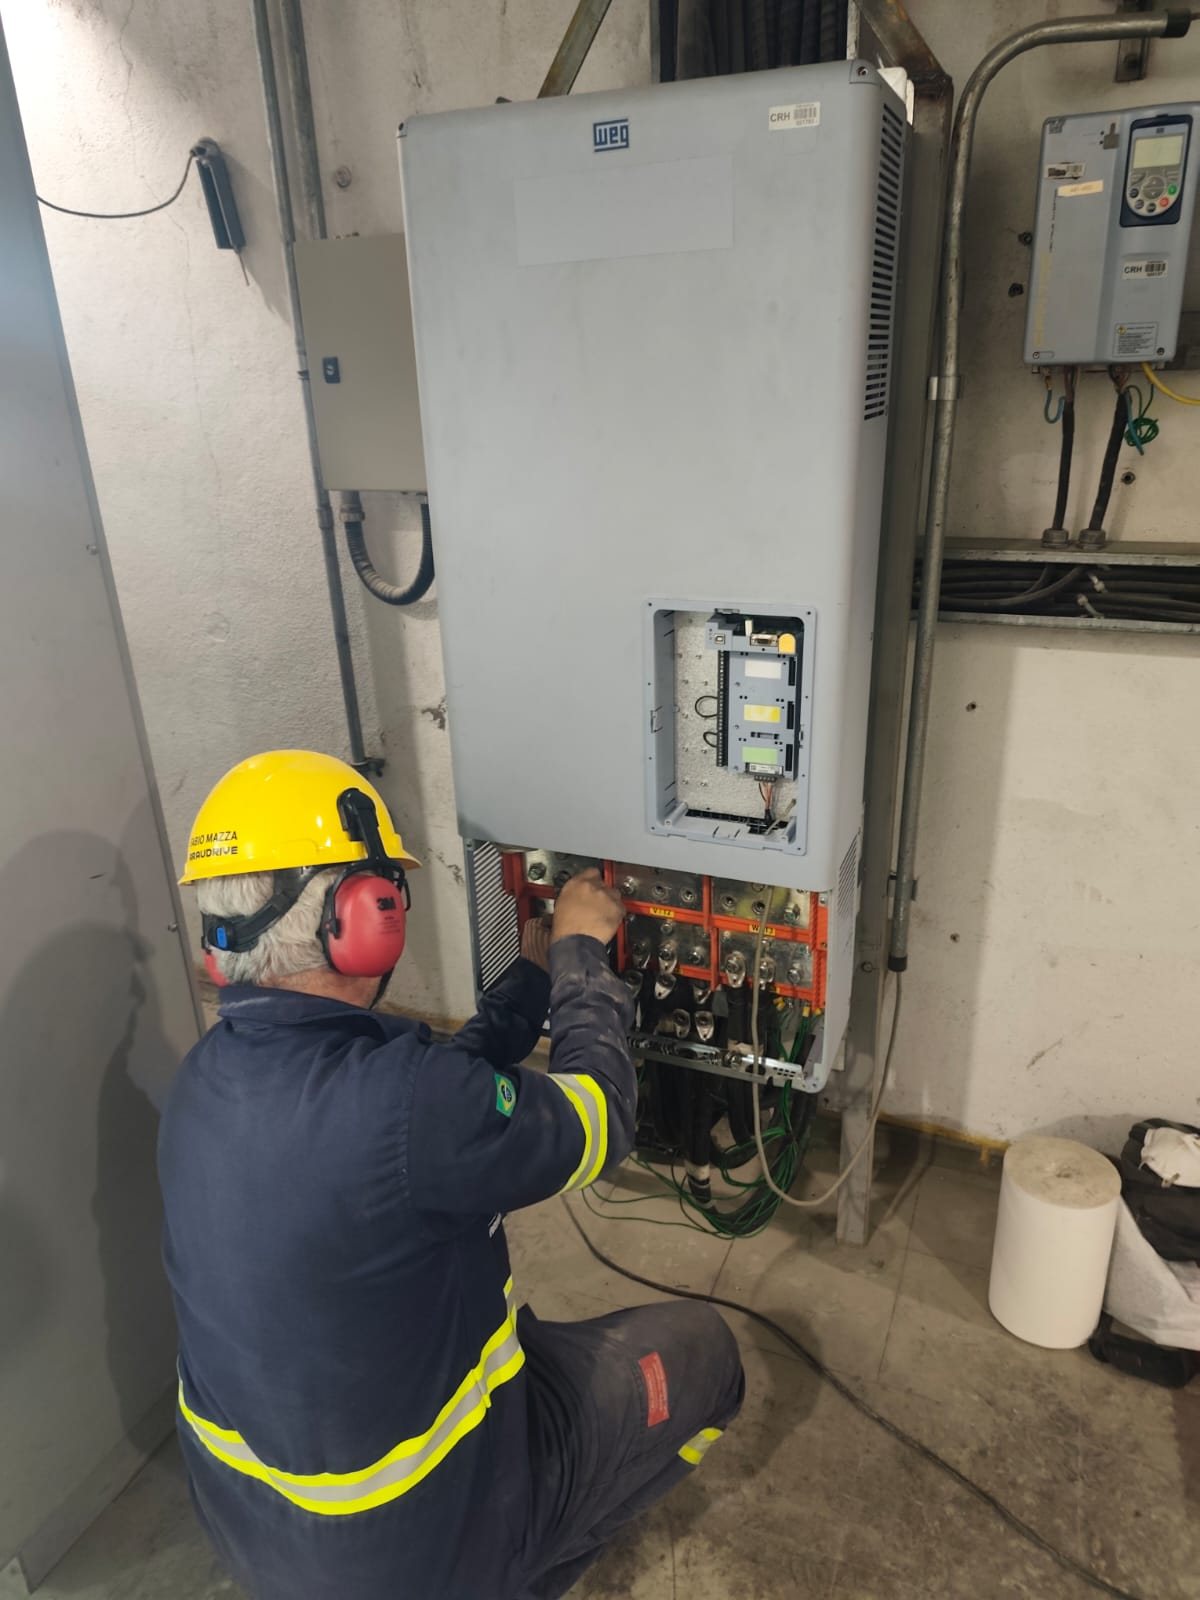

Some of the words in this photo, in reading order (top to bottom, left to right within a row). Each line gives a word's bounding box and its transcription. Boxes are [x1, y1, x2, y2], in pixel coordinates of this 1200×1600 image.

[770, 112, 791, 122] CRH
[1124, 265, 1143, 274] CRH
[206, 831, 238, 843] MAZZA
